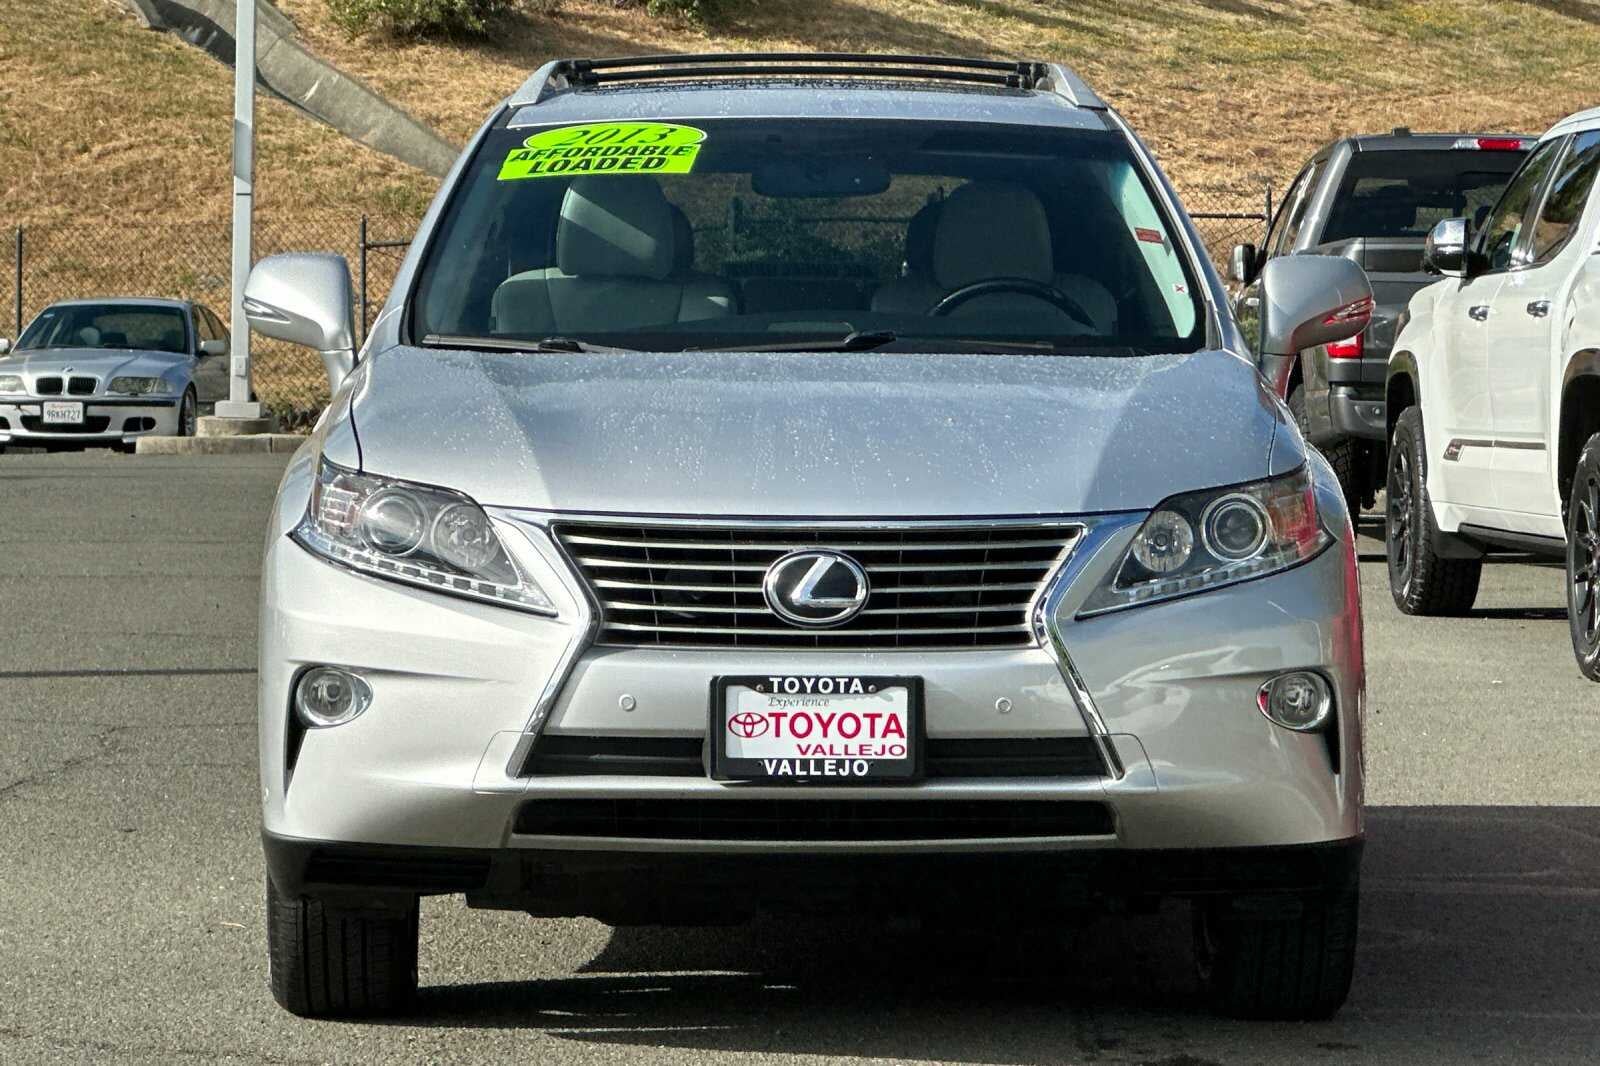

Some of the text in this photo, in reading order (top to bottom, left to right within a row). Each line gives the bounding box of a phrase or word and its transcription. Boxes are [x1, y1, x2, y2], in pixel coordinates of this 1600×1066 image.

[552, 128, 678, 147] 2013
[508, 145, 694, 162] AFFORDABLE
[527, 157, 669, 174] LOADED
[769, 677, 865, 694] TOYOTA
[768, 696, 830, 709] Experience
[767, 712, 905, 739] TOYOTA
[796, 743, 906, 757] VALLEJO
[763, 759, 869, 776] VALLEJO
